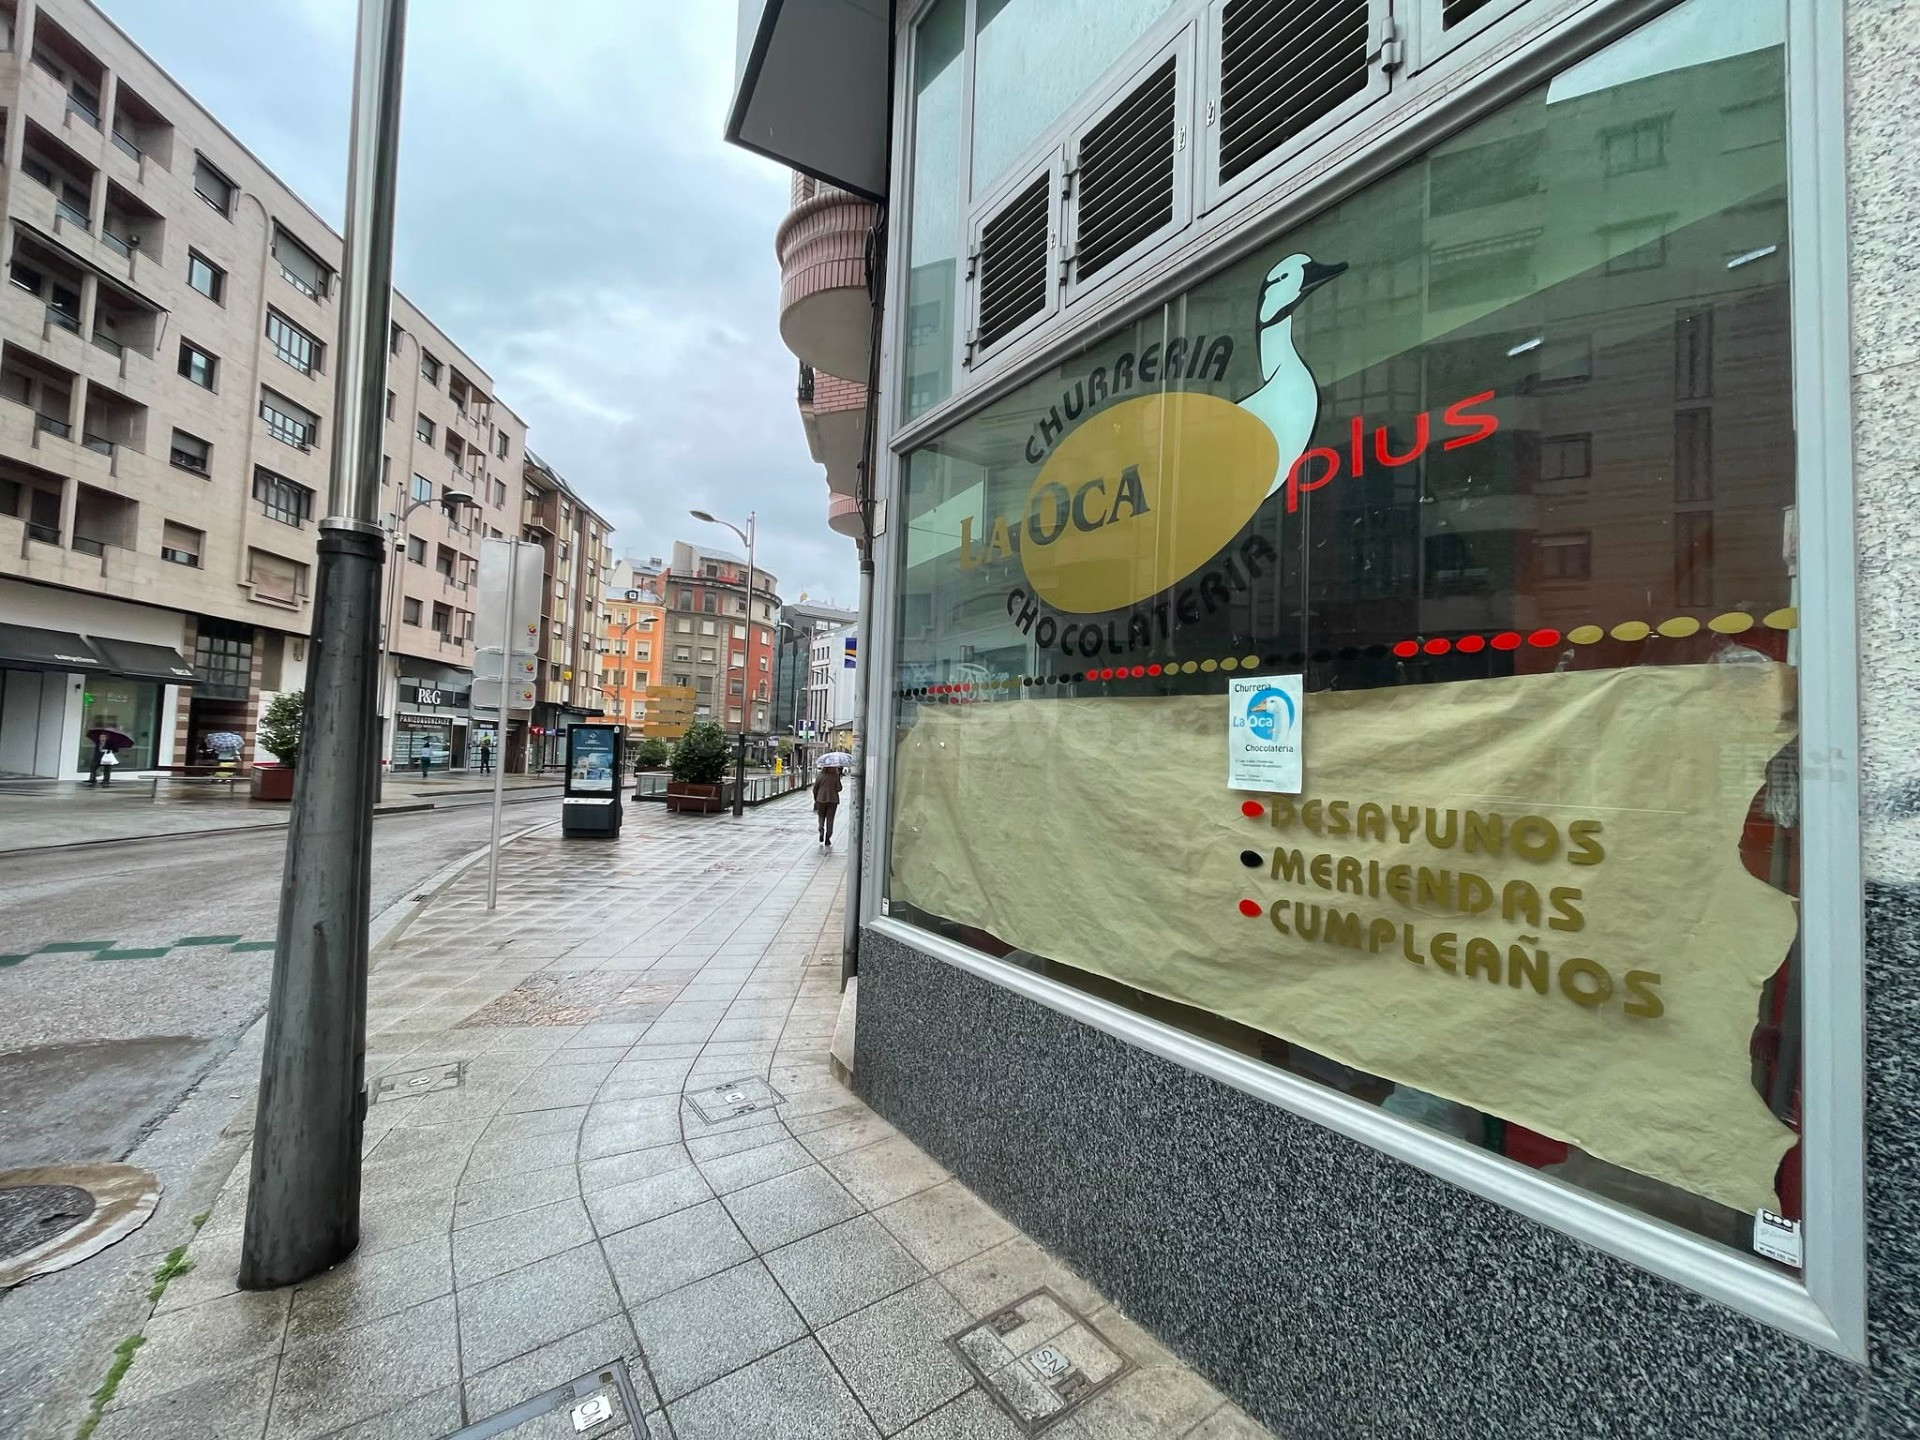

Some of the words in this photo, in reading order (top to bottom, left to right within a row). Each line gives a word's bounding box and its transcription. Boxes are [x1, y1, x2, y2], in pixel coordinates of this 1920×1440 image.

[1024, 333, 1234, 465] CHURRERIA
[1286, 389, 1499, 513] plus
[959, 514, 1014, 571] LA
[1027, 463, 1151, 546] OCA
[1005, 533, 1279, 658] CHOCOLATERIA
[417, 687, 441, 705] P&G
[1232, 715, 1245, 728] La
[1248, 714, 1273, 728] Oca
[1270, 795, 1606, 866] DESAYUNOS
[1269, 846, 1586, 932] MERIENDAS
[1269, 898, 1666, 1020] CUMPLEAÑOS
